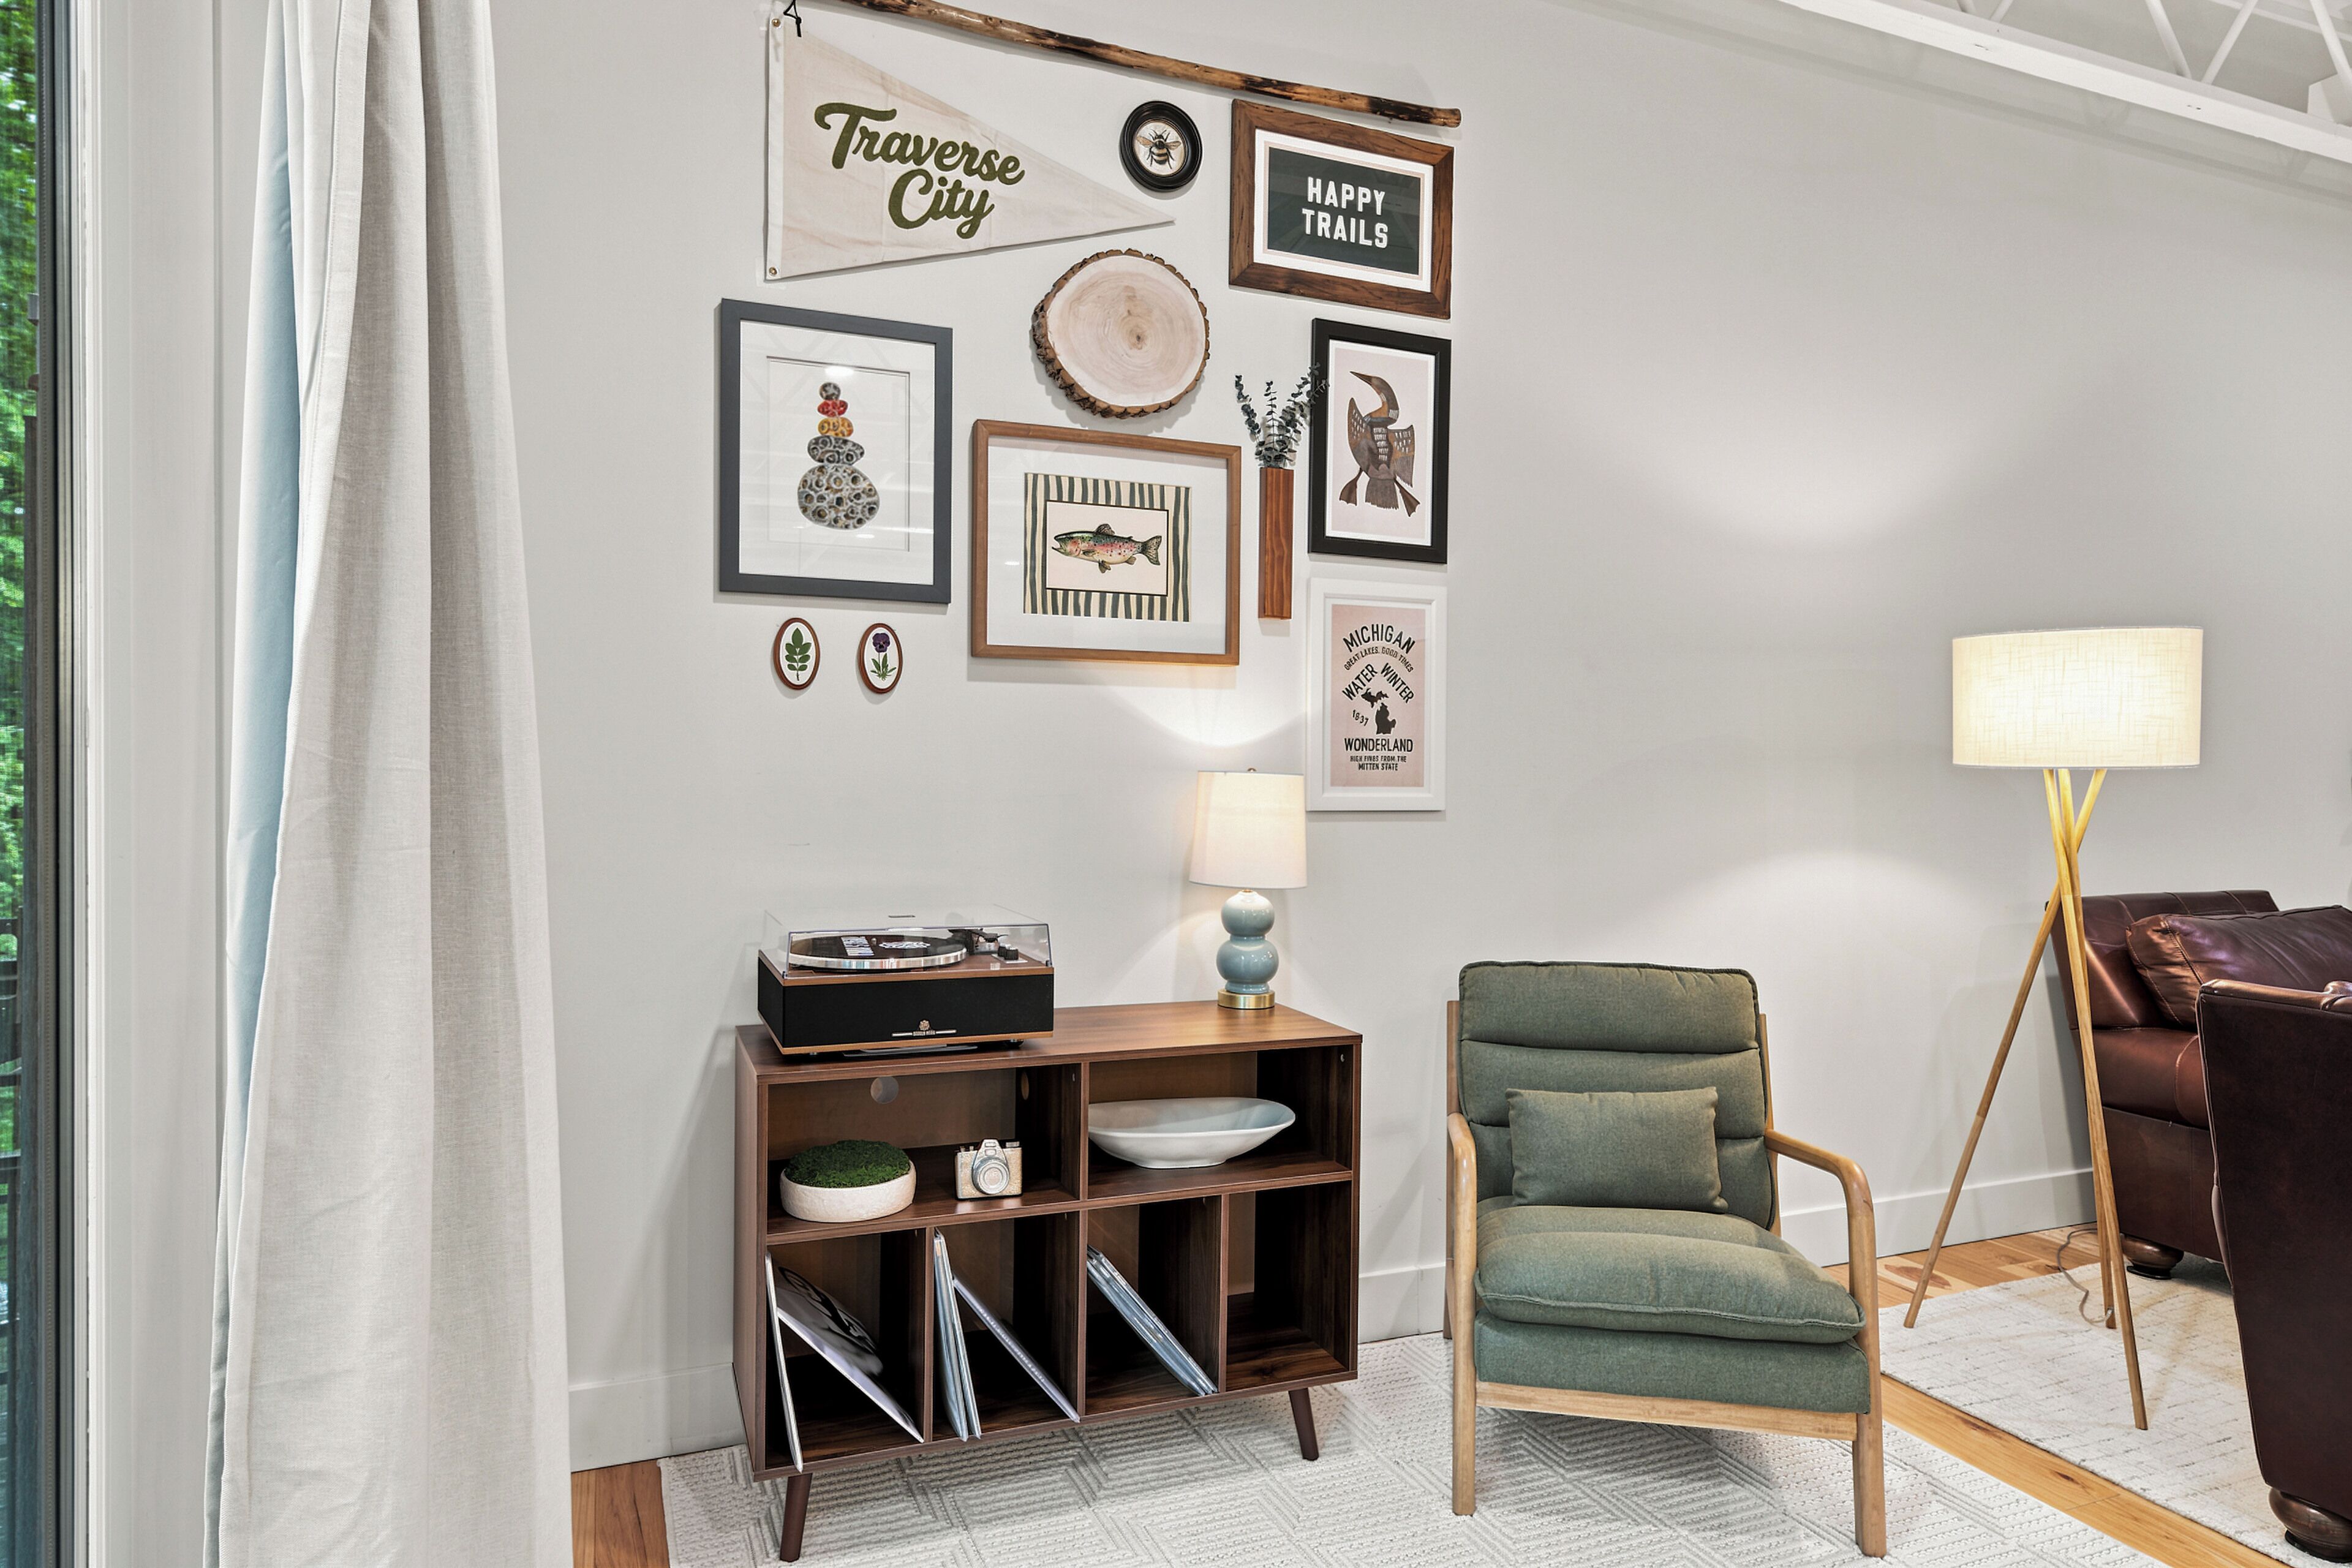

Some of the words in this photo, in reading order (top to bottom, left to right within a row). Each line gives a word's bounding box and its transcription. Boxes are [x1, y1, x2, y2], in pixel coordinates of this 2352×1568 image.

[814, 102, 1025, 186] Traverse
[888, 169, 995, 239] City
[1307, 176, 1385, 216] HAPPY
[1302, 208, 1389, 249] TRAILS
[1343, 624, 1415, 654] MICHIGAN
[1344, 653, 1360, 671] GREAT
[1381, 646, 1398, 658] GOOD
[1398, 655, 1414, 673] TIMES
[1342, 664, 1378, 701] WATER
[1381, 663, 1414, 704] WINTER
[1352, 709, 1369, 726] 1837
[1344, 737, 1413, 752] WONDERLAND
[1381, 763, 1398, 771] STATE
